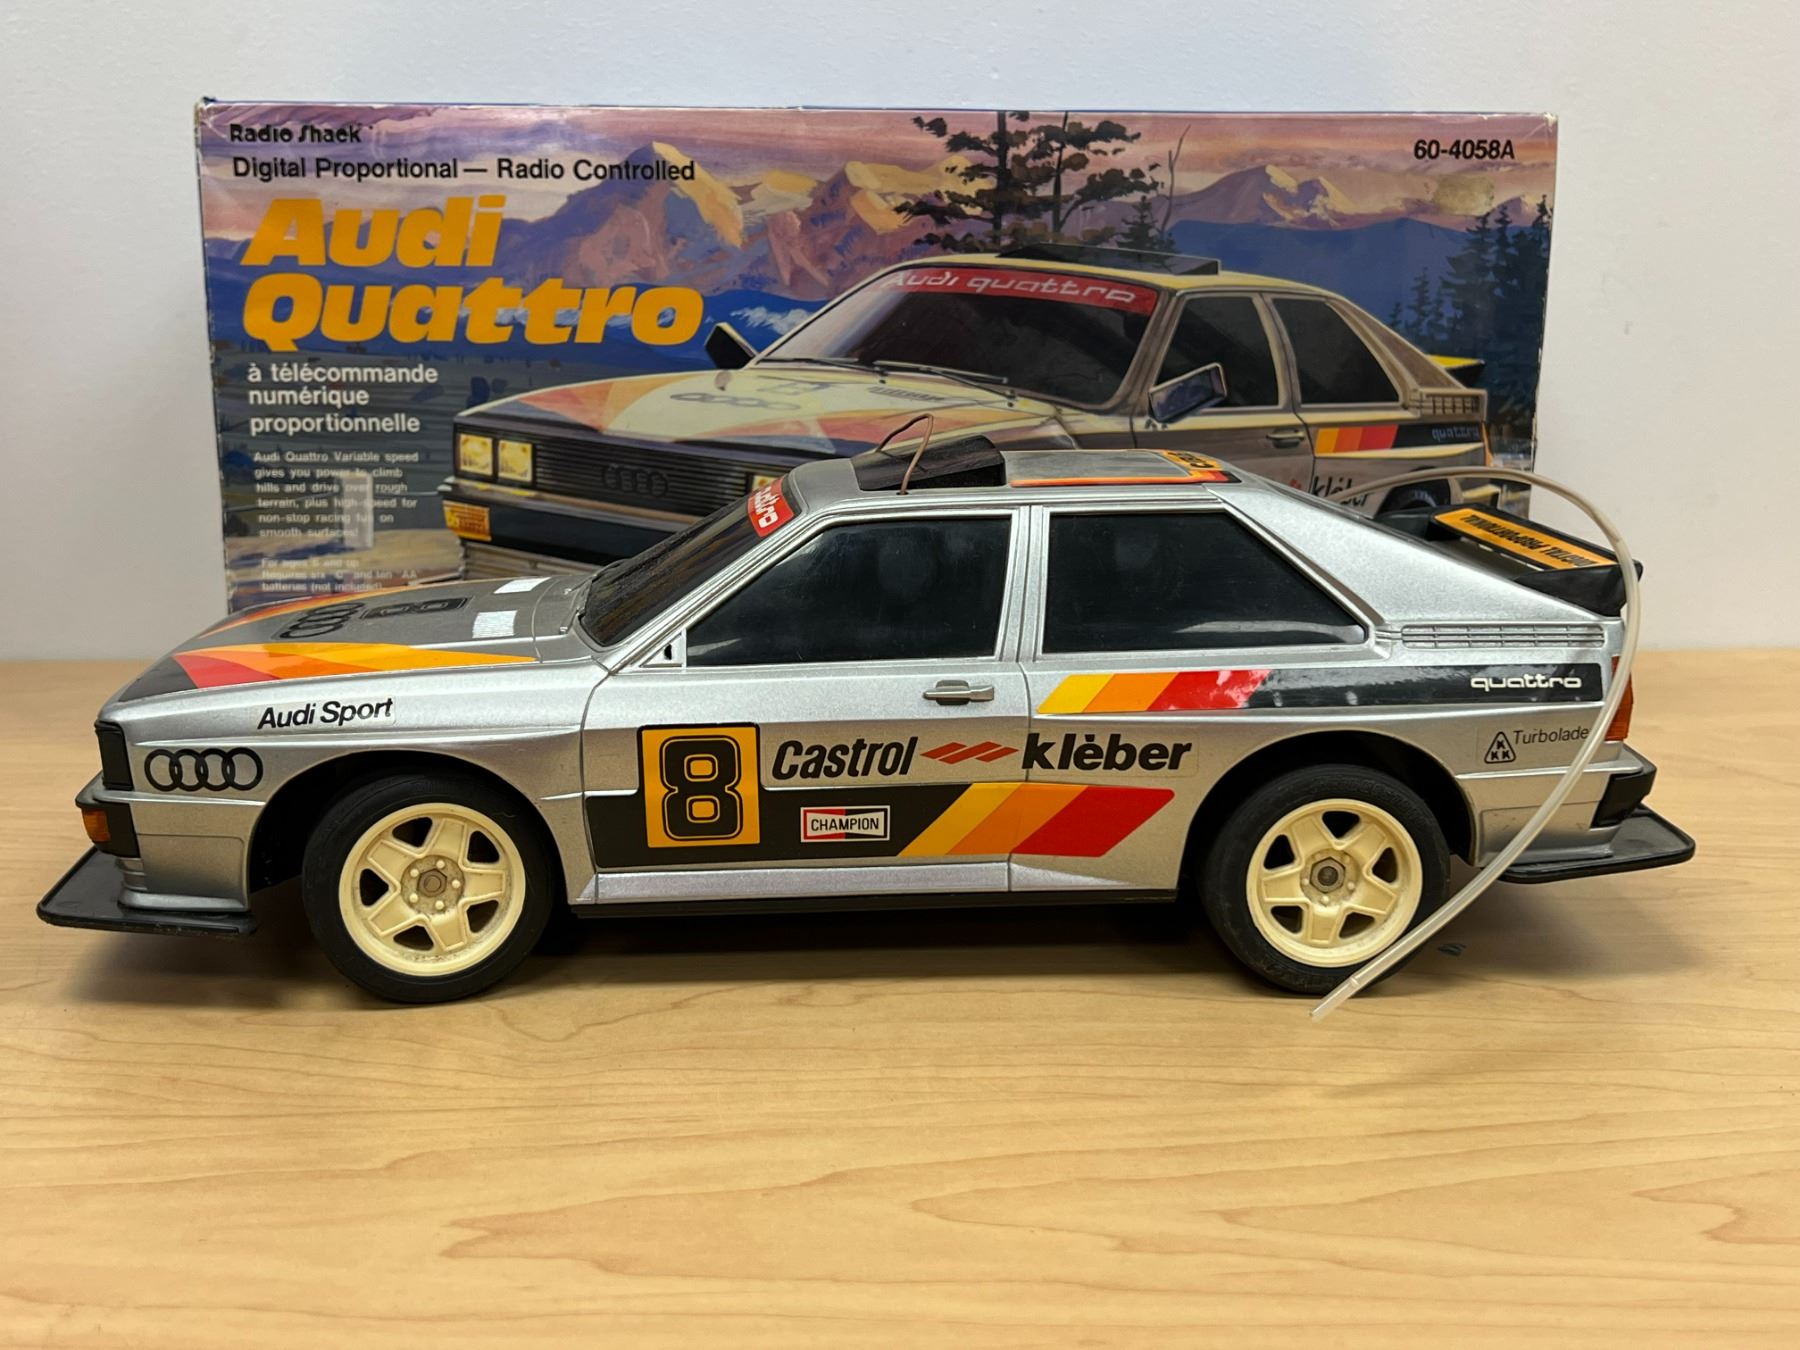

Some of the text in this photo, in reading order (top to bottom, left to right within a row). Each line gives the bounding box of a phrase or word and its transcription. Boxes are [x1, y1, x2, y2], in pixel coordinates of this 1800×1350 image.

[229, 123, 293, 143] Radio
[1413, 139, 1515, 160] 60-4058A
[233, 157, 306, 183] Digital
[315, 157, 459, 183] Proportional
[497, 157, 565, 179] Radio
[573, 159, 695, 181] Controlled
[240, 194, 507, 268] Audi
[880, 270, 1137, 303] Audi quattro
[242, 272, 705, 353] Quattro
[247, 362, 440, 383] à télécommande
[248, 386, 371, 409] numérique
[250, 412, 421, 437] proportionnelle
[253, 450, 419, 464] Audi Quattro Variable speed
[254, 467, 285, 480] gives
[289, 468, 311, 480] you
[372, 467, 404, 478] climb
[256, 482, 280, 493] hills
[284, 482, 306, 493] and
[311, 482, 340, 493] drive
[375, 482, 408, 495] rough
[304, 497, 329, 509] plus
[401, 497, 418, 508] for
[259, 512, 310, 524] non-stop
[379, 513, 395, 523] on
[259, 527, 302, 537] smooth
[1470, 673, 1582, 692] quattro
[257, 697, 393, 730] Audi Sport
[772, 736, 919, 780] Castrol
[659, 735, 744, 842] 8
[810, 817, 880, 832] CHAMPION
